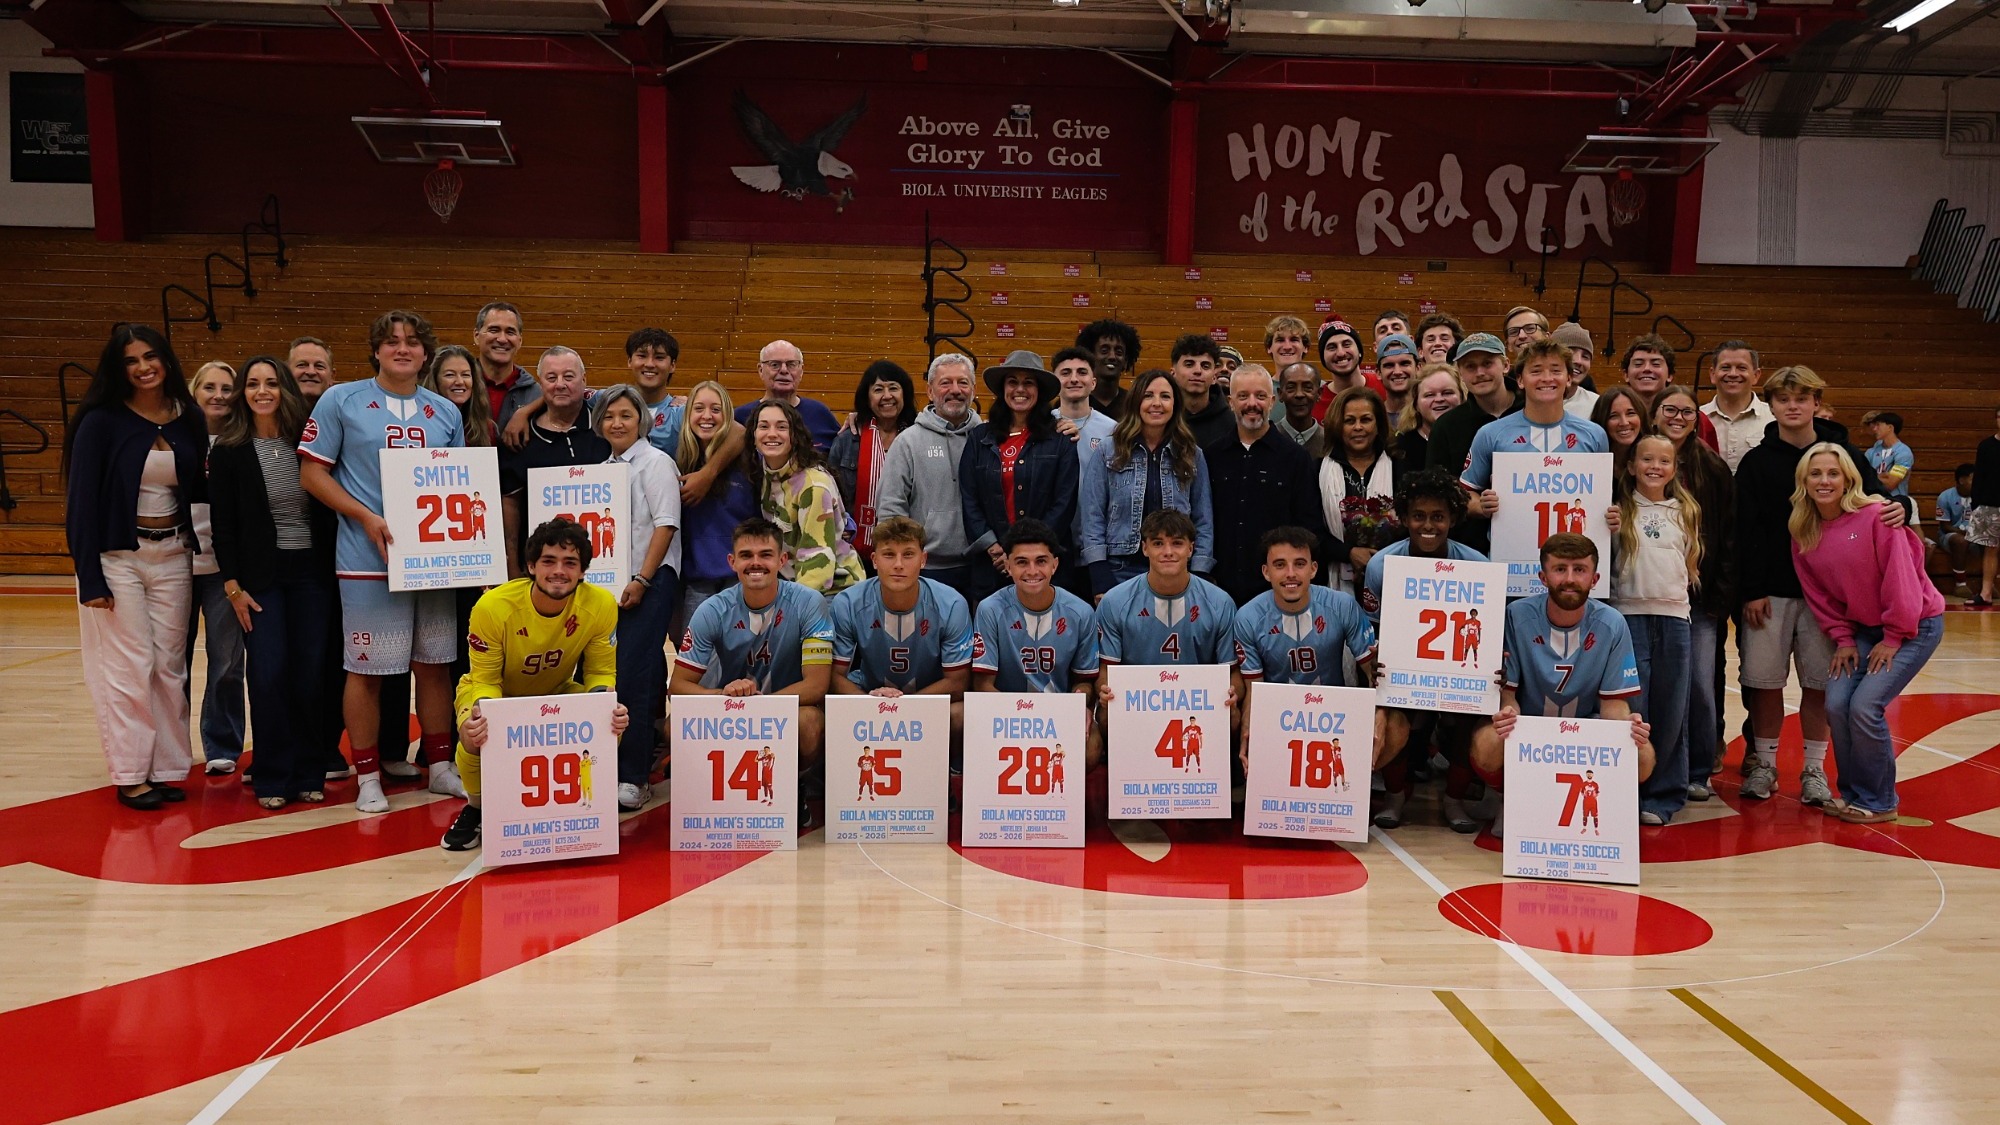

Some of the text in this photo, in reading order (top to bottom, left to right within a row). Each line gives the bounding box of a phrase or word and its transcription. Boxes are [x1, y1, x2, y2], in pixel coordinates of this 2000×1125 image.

[898, 116, 1110, 140] Above All, Give
[908, 143, 1102, 170] Glory To God
[1227, 117, 1392, 182] HOME
[902, 184, 1107, 200] BIOLA UNIVERSITY EAGLES
[1239, 152, 1613, 255] of the Red SEA
[385, 425, 426, 448] 29
[414, 466, 470, 487] SMITH
[1513, 473, 1593, 494] LARSON
[543, 483, 611, 506] SETTERS
[417, 494, 474, 542] 29
[1534, 502, 1569, 549] 11
[405, 554, 491, 569] BIOLA MEN'S SOCCER
[587, 572, 614, 583] SOCCER
[1405, 578, 1485, 604] BEYENE
[352, 632, 371, 646] 29
[1417, 609, 1466, 661] 21
[747, 640, 771, 667] 14
[1160, 633, 1181, 661] 4
[521, 648, 564, 675] 99
[890, 647, 909, 674] 5
[1020, 646, 1055, 674] 28
[1287, 646, 1317, 673] 18
[1391, 672, 1487, 691] BIOLA MEN'S SOCCER
[1554, 664, 1574, 693] 7
[1126, 690, 1214, 711] MICHAEL
[1387, 696, 1407, 704] 2025
[1415, 699, 1436, 707] 2026
[683, 718, 787, 740] KINGSLEY
[853, 721, 923, 741] GLAAB
[993, 718, 1057, 738] PIERRA
[1280, 710, 1345, 734] CALOZ
[507, 721, 593, 748] MINEIRO
[1155, 720, 1186, 768] 4
[1288, 740, 1333, 788] 18
[1519, 743, 1622, 767] McGREEVEY
[521, 753, 581, 807] 99
[708, 750, 761, 801] 14
[874, 750, 901, 796] 5
[998, 747, 1050, 795] 28
[1124, 783, 1217, 795] BIOLA MEN'S SOCCER
[1556, 773, 1584, 826] 7
[840, 810, 934, 820] BIOLA MEN'S SOCCER
[982, 810, 1065, 820] BIOLA MEN'S SOCCER
[1262, 800, 1352, 815] BIOLA MEN'S SOCCER
[503, 817, 599, 837] BIOLA MEN'S SOCCER
[684, 817, 784, 828] BIOLA MEN'S SOCCER
[530, 847, 551, 855] 2026
[1520, 841, 1620, 859] BIOLA MEN'S SOCCER
[1518, 867, 1538, 875] 2023
[1548, 869, 1569, 877] 2026
[1547, 860, 1568, 869] FORWARD
[1573, 862, 1585, 870] JOHN
